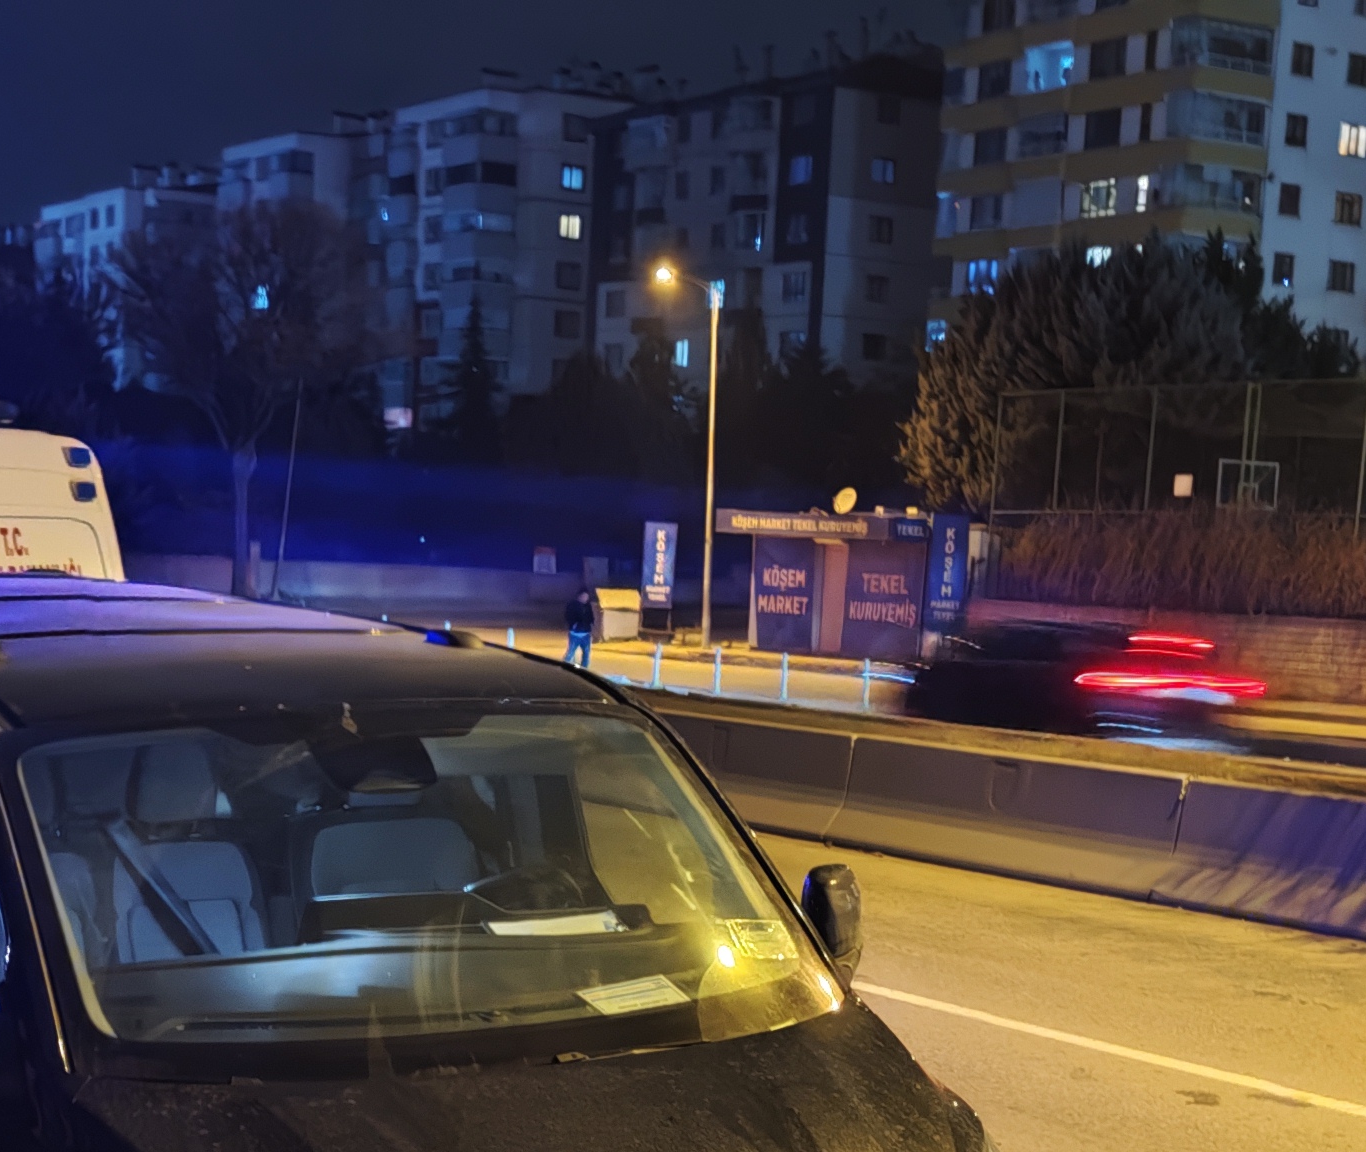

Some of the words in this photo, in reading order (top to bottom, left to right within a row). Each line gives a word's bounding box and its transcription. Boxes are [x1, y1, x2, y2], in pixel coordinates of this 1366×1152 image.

[759, 517, 791, 530] MARKET
[792, 519, 817, 532] TEKEL
[897, 523, 925, 537] TEKEL
[763, 564, 806, 591] KÖŞEM
[862, 572, 909, 595] TEKEL
[758, 594, 808, 616] MARKET
[849, 598, 917, 628] KURUYEMİŞ
